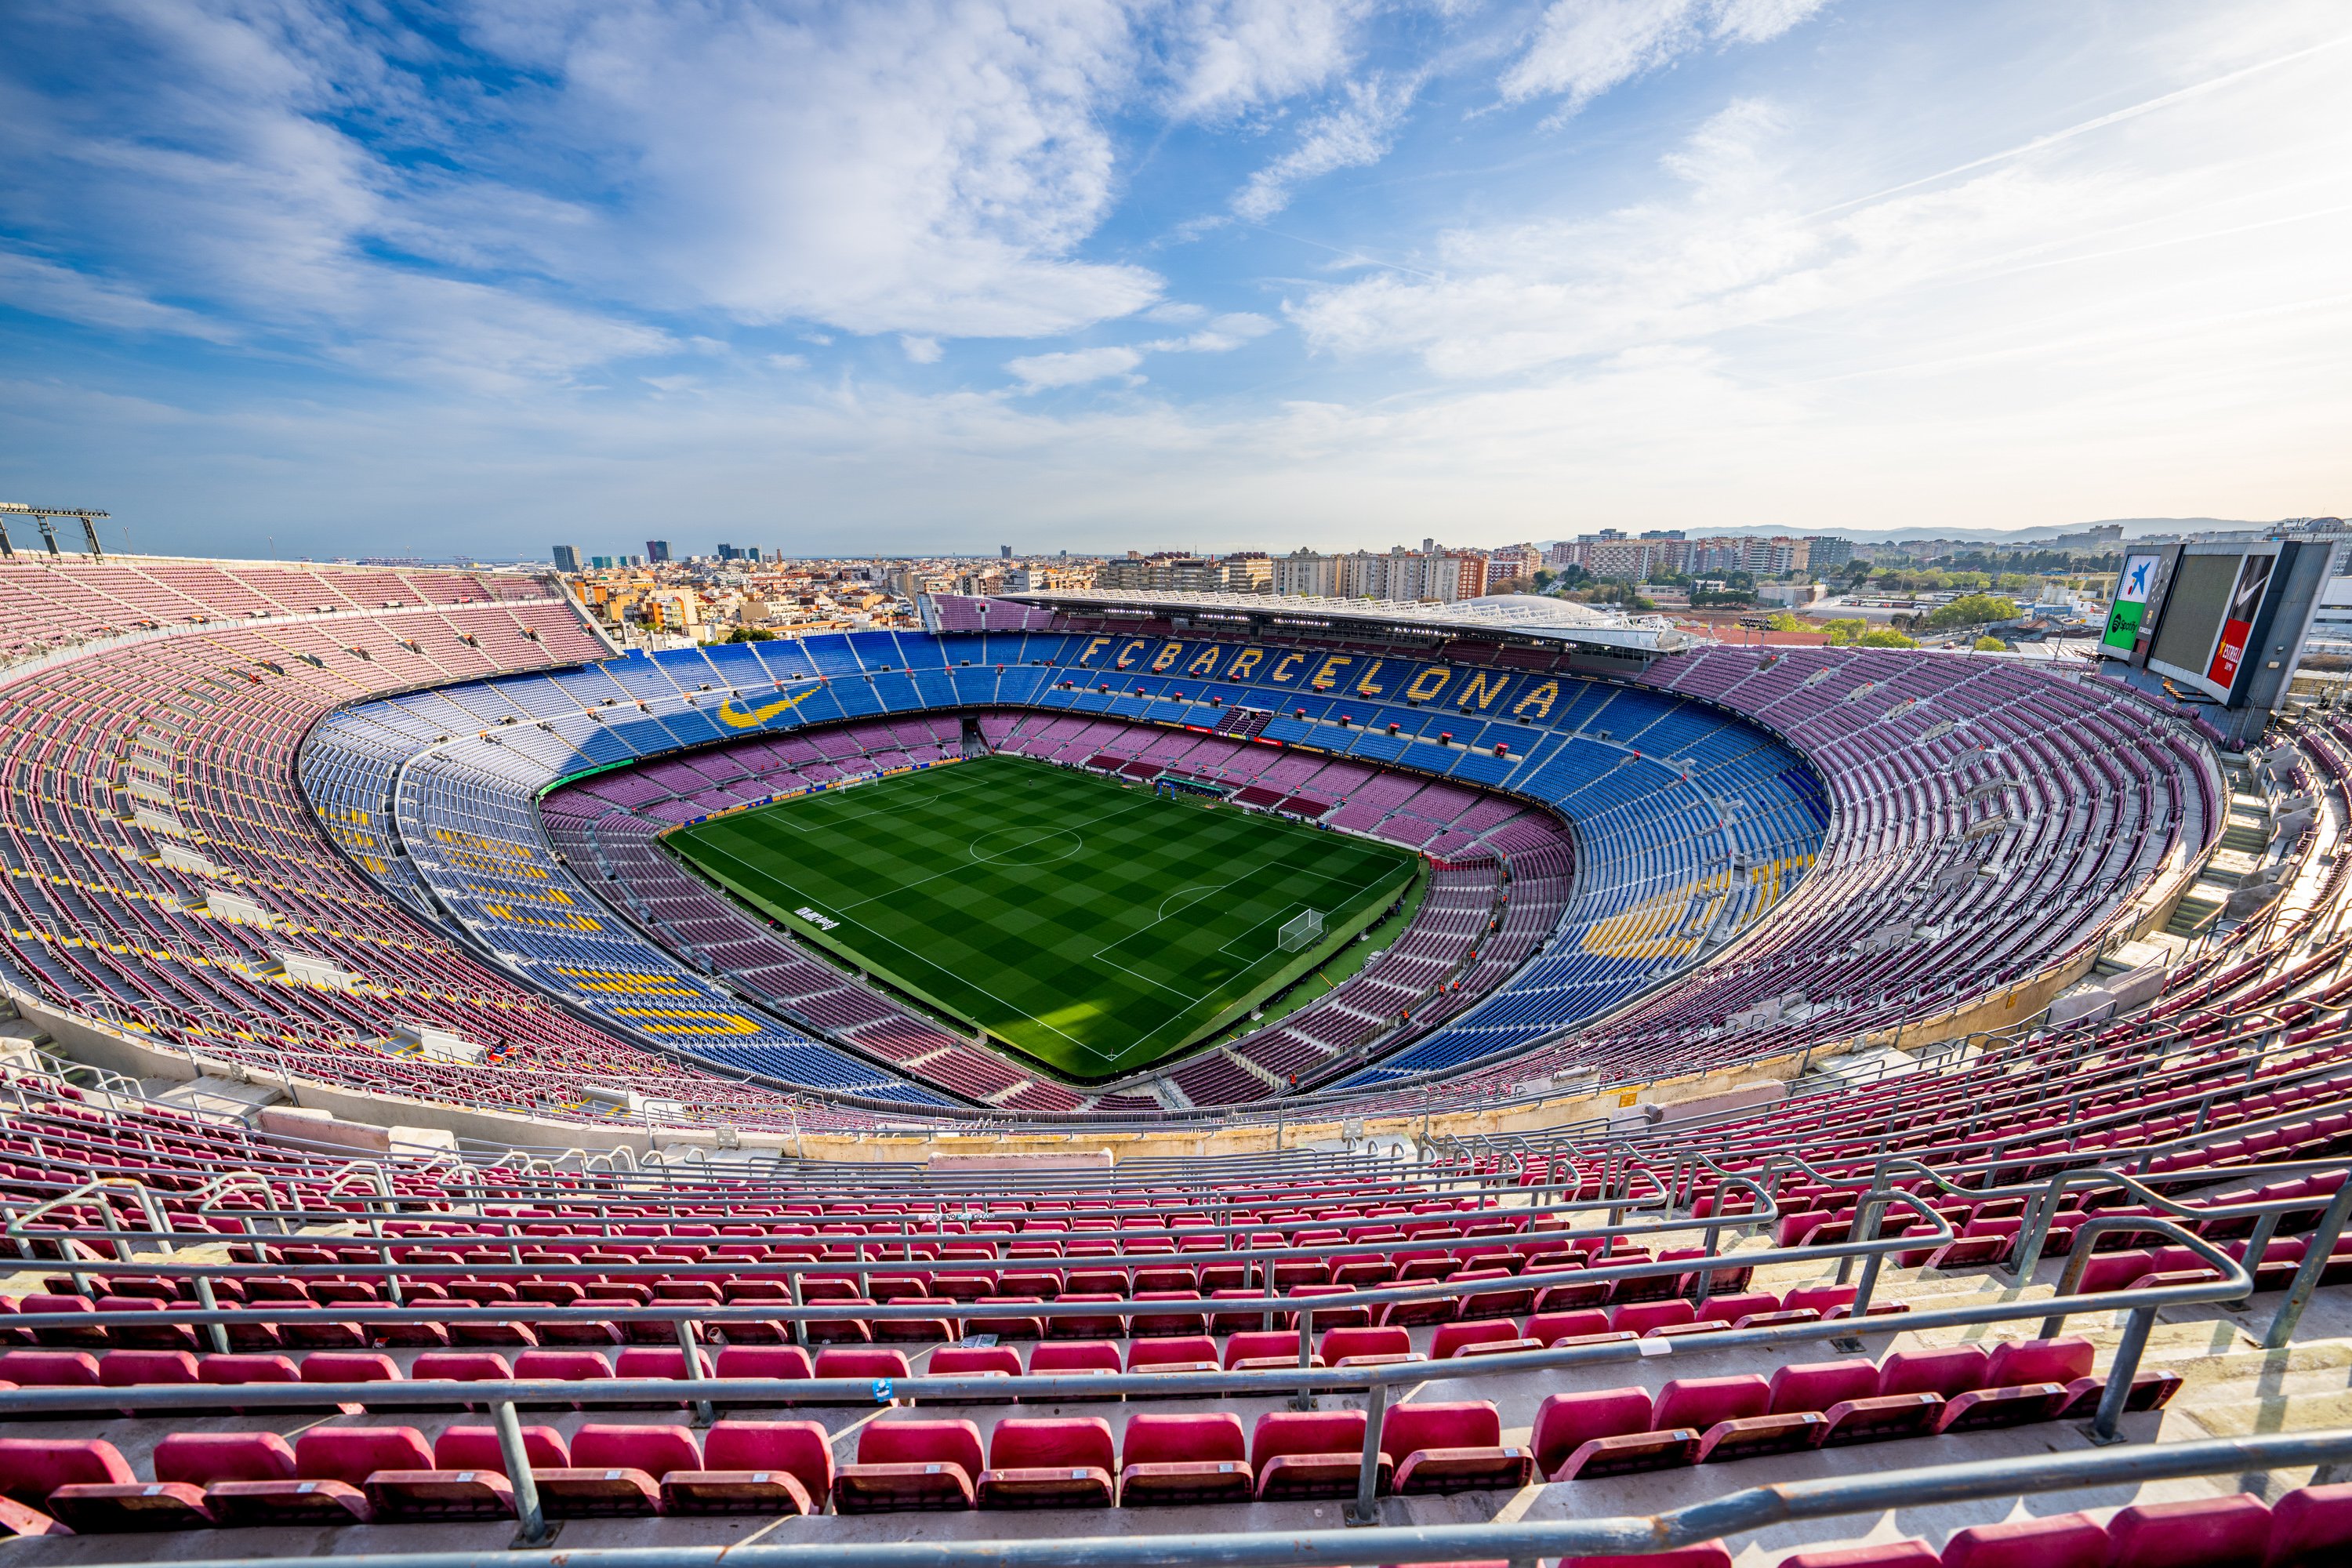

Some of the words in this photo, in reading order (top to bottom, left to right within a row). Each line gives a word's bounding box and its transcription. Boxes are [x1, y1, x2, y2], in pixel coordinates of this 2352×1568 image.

[2120, 619, 2137, 633] Spotify
[1080, 637, 1145, 666] FC
[1152, 641, 1559, 718] BARCELONA
[790, 789, 807, 798] INTENSITY
